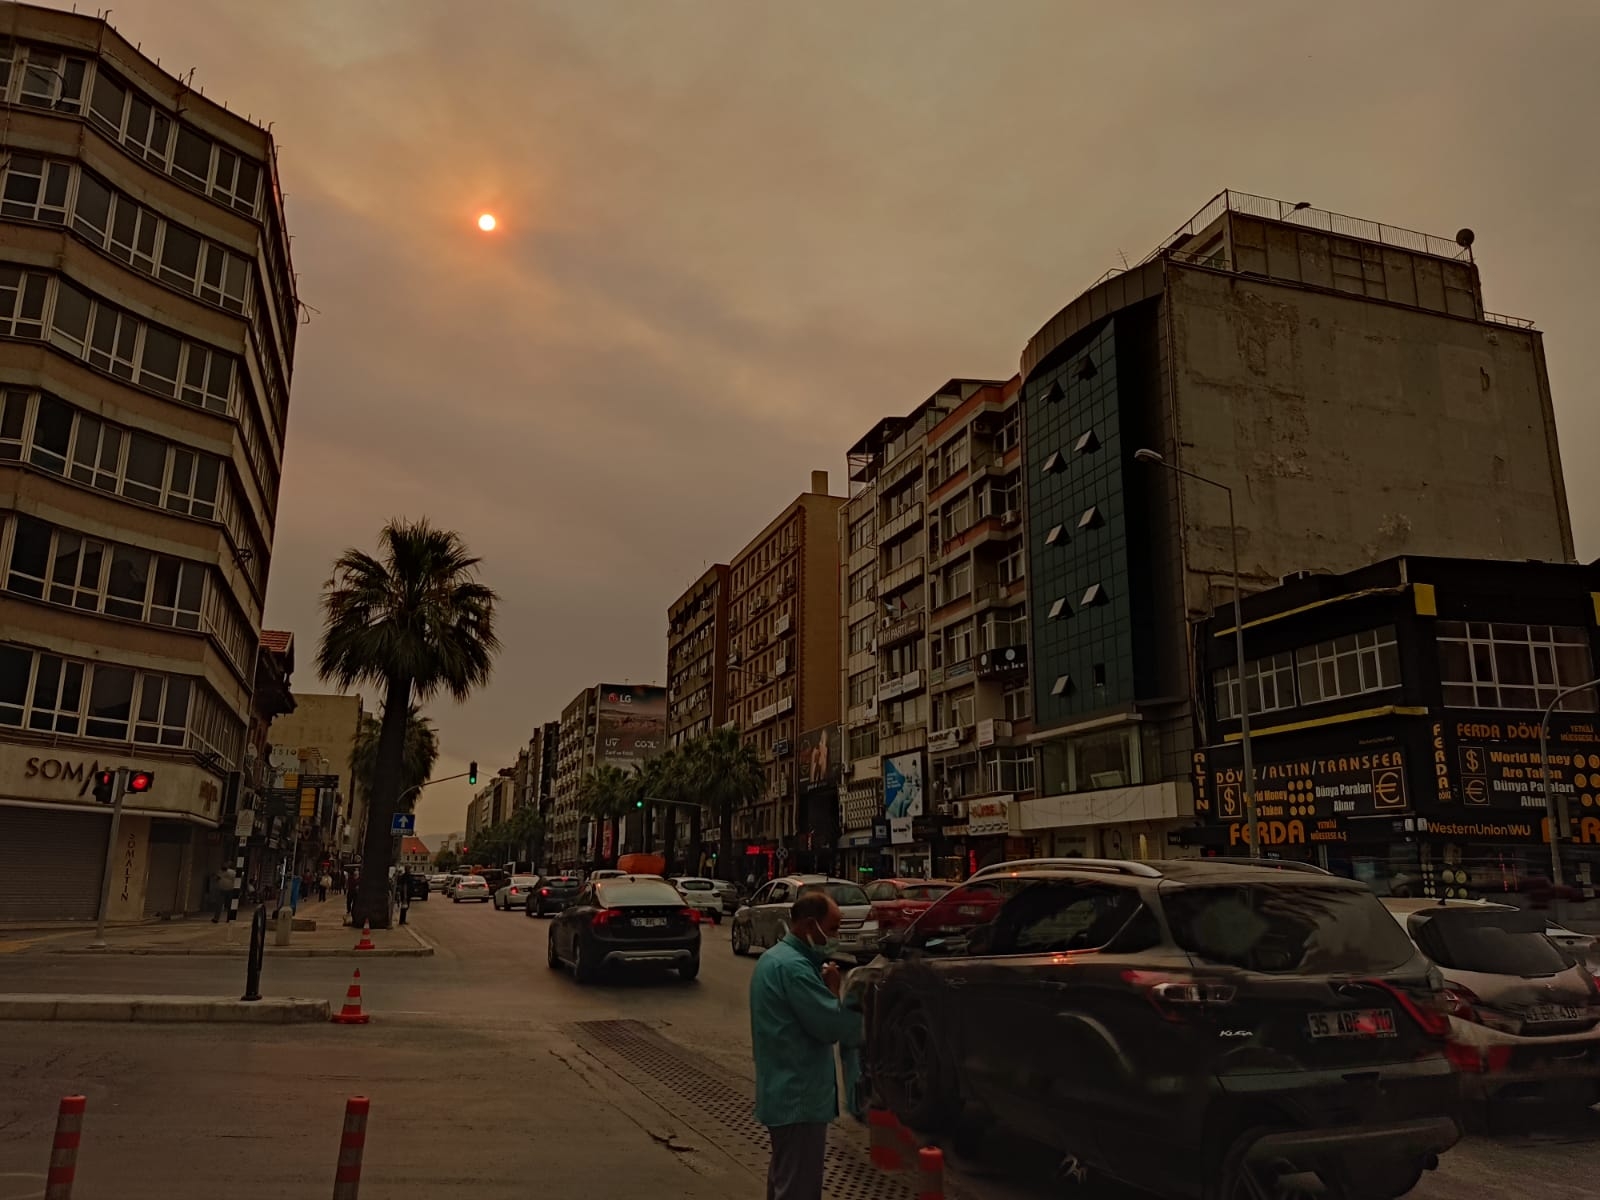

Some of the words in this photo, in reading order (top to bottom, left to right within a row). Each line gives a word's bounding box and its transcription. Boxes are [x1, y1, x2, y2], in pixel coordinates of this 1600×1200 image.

[620, 694, 632, 704] LG
[1457, 723, 1501, 738] FERDA
[1433, 723, 1449, 789] FERDA
[1490, 752, 1528, 763] World
[1530, 752, 1571, 766] Mney
[1502, 767, 1523, 778] Are
[1193, 752, 1209, 811] ALTIN
[1493, 780, 1528, 792] Dünya
[1310, 1014, 1330, 1035] 35
